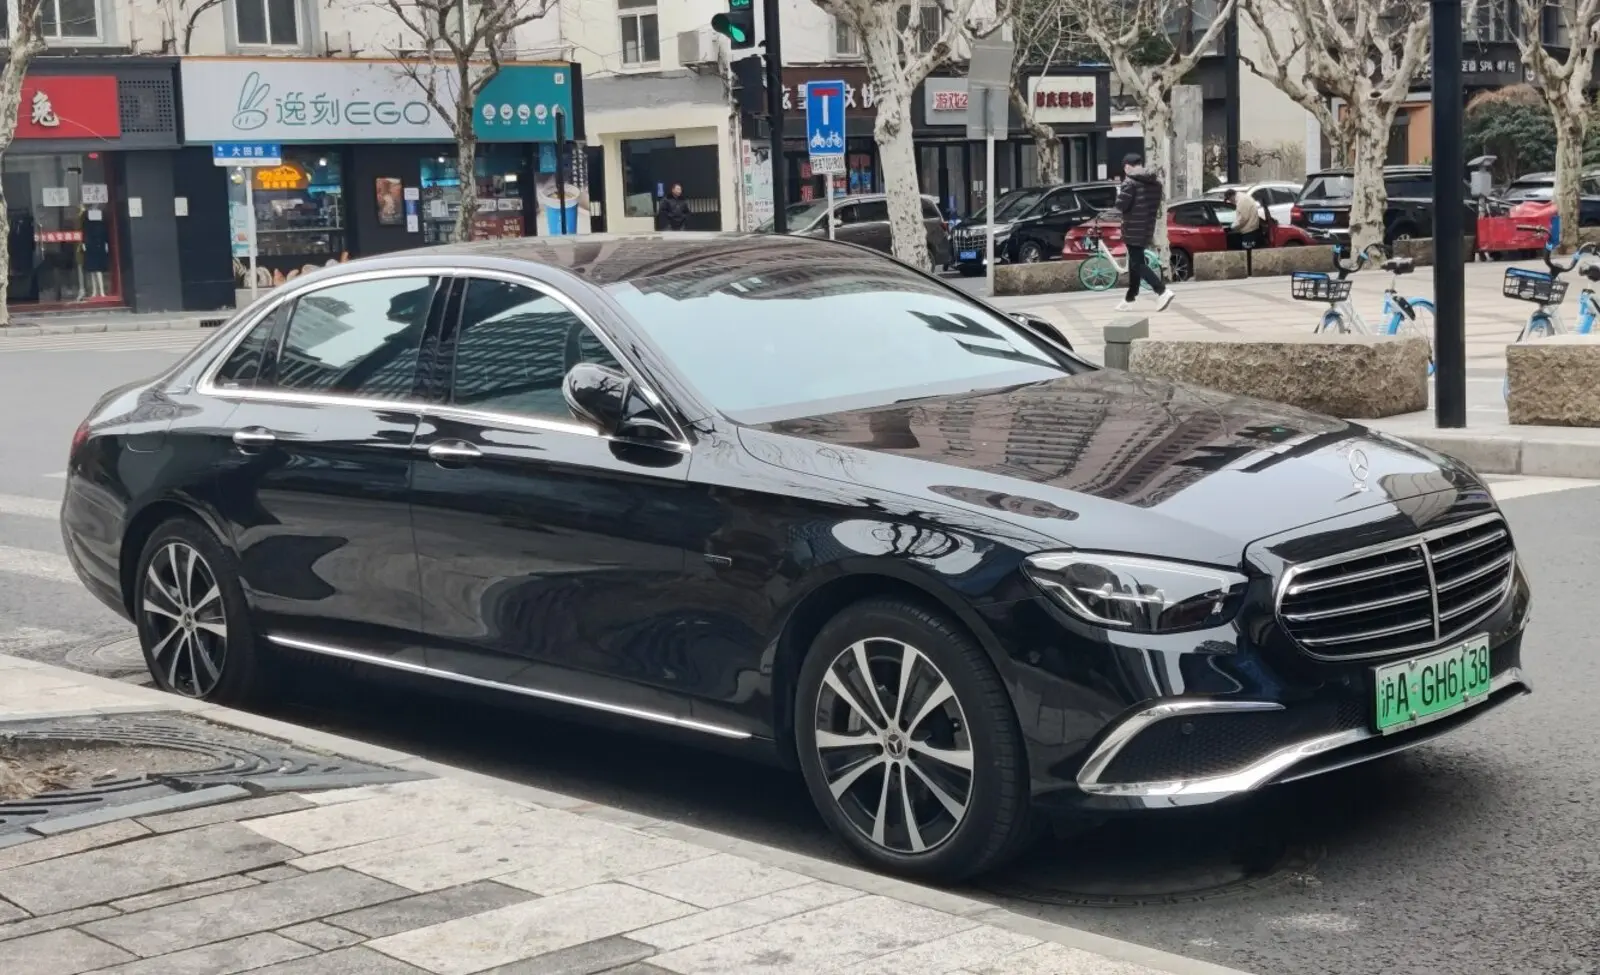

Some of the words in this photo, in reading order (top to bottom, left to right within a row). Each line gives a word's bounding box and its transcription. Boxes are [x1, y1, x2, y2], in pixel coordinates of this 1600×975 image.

[1480, 60, 1494, 72] SPA
[275, 92, 340, 126] 逸刻
[344, 101, 430, 125] EGO
[232, 146, 264, 157] 大田路
[1382, 672, 1409, 718] 沪A
[1421, 645, 1488, 706] GH6138
